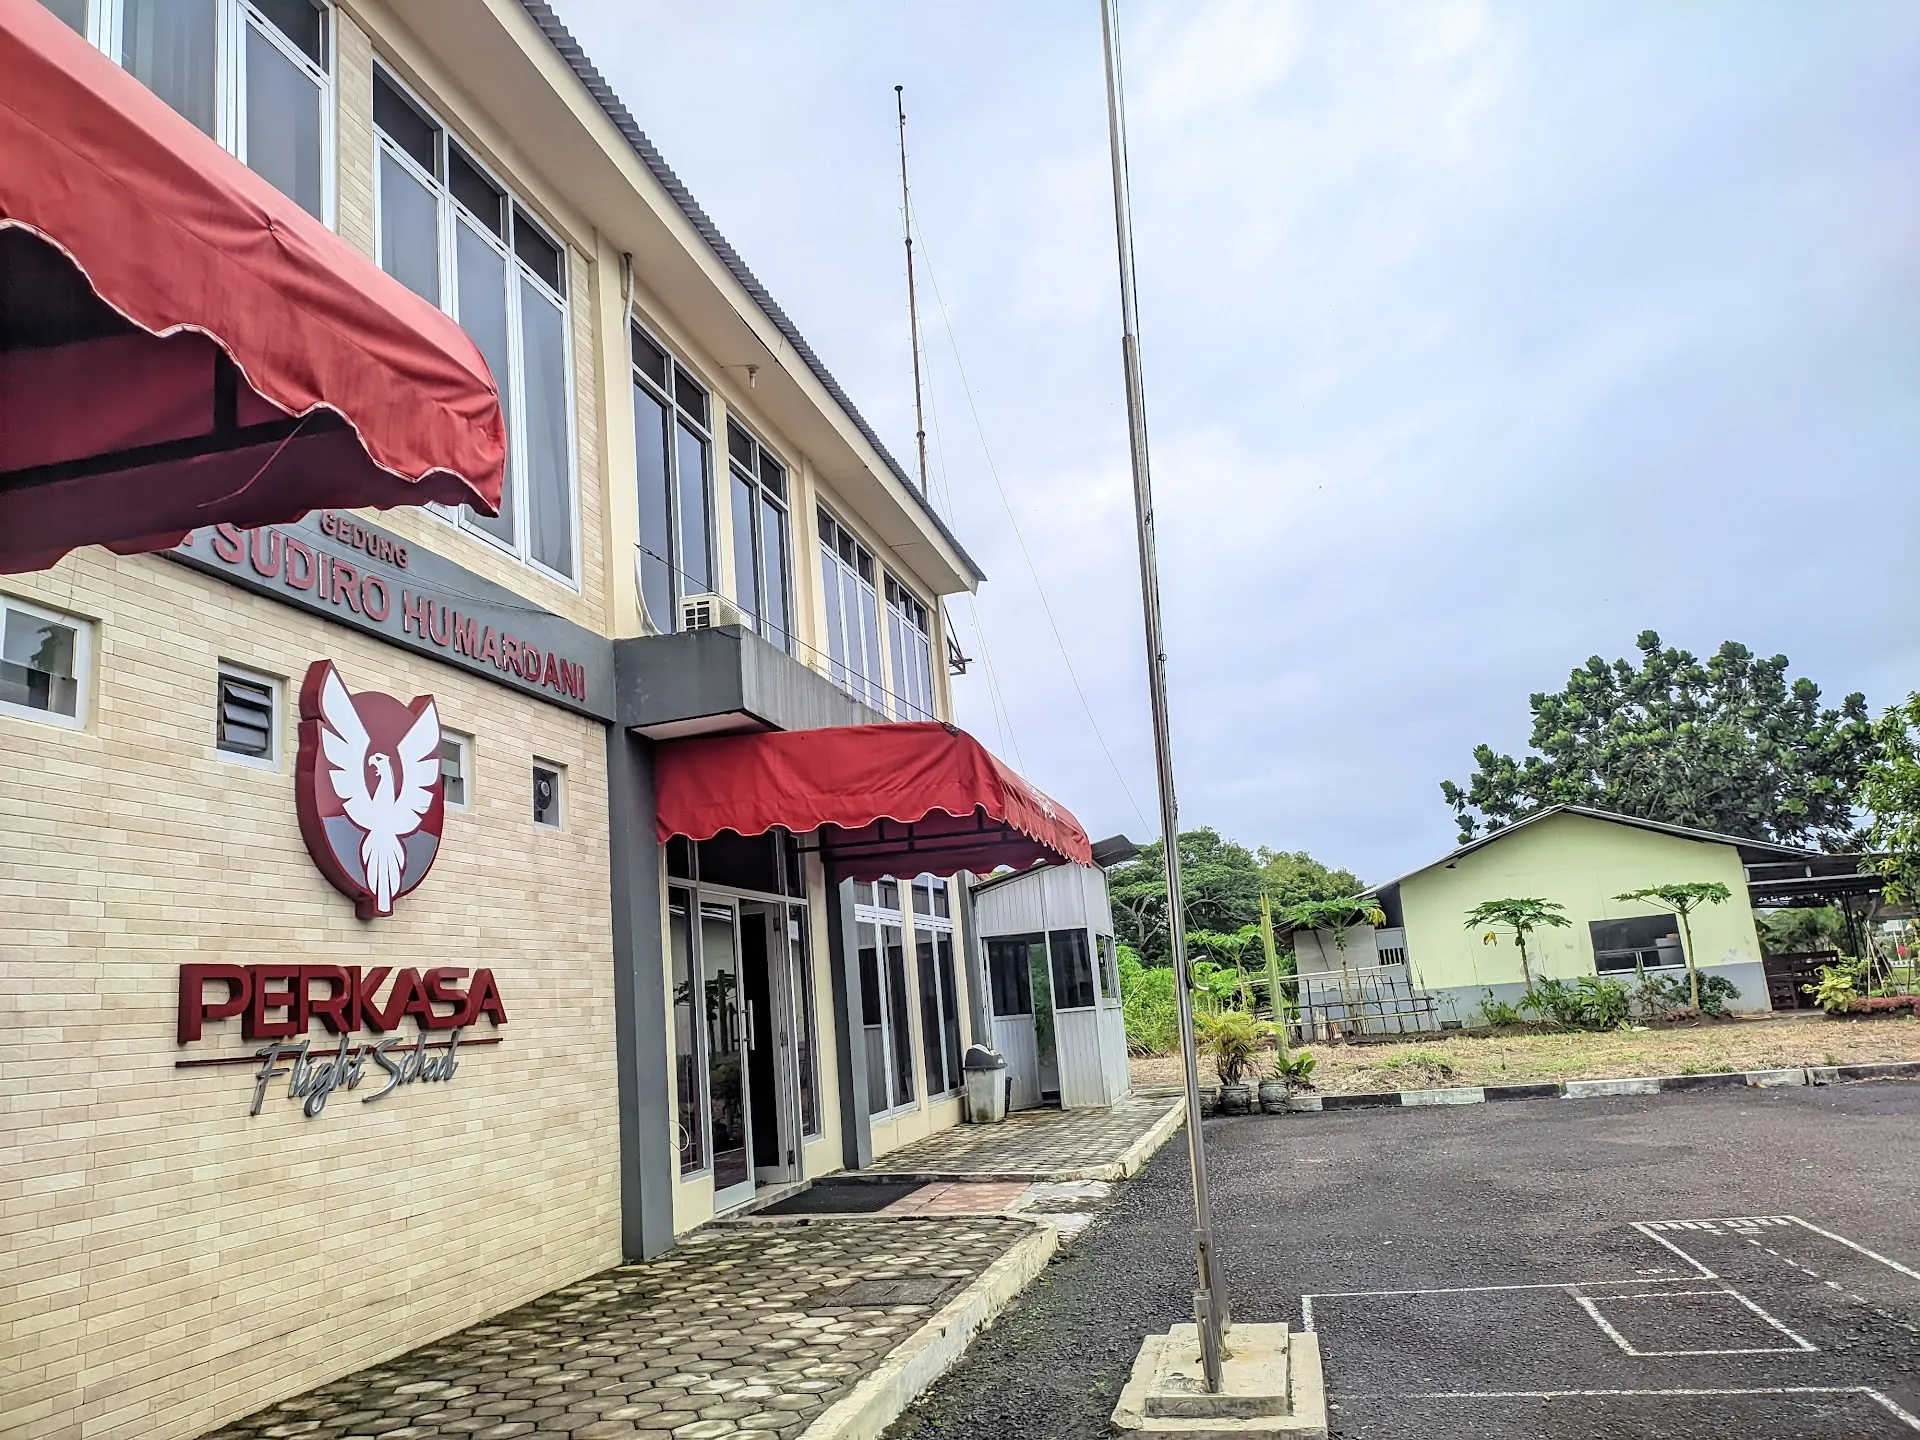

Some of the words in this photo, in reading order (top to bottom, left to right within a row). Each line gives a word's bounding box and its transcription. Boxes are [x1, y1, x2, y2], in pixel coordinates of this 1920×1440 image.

[320, 509, 410, 569] GEDUNG
[212, 522, 391, 622] SUDIRO
[403, 588, 587, 702] HUMARDANI
[178, 963, 508, 1045] PERKASA
[250, 1032, 366, 1117] Flight
[362, 1030, 460, 1102] School
